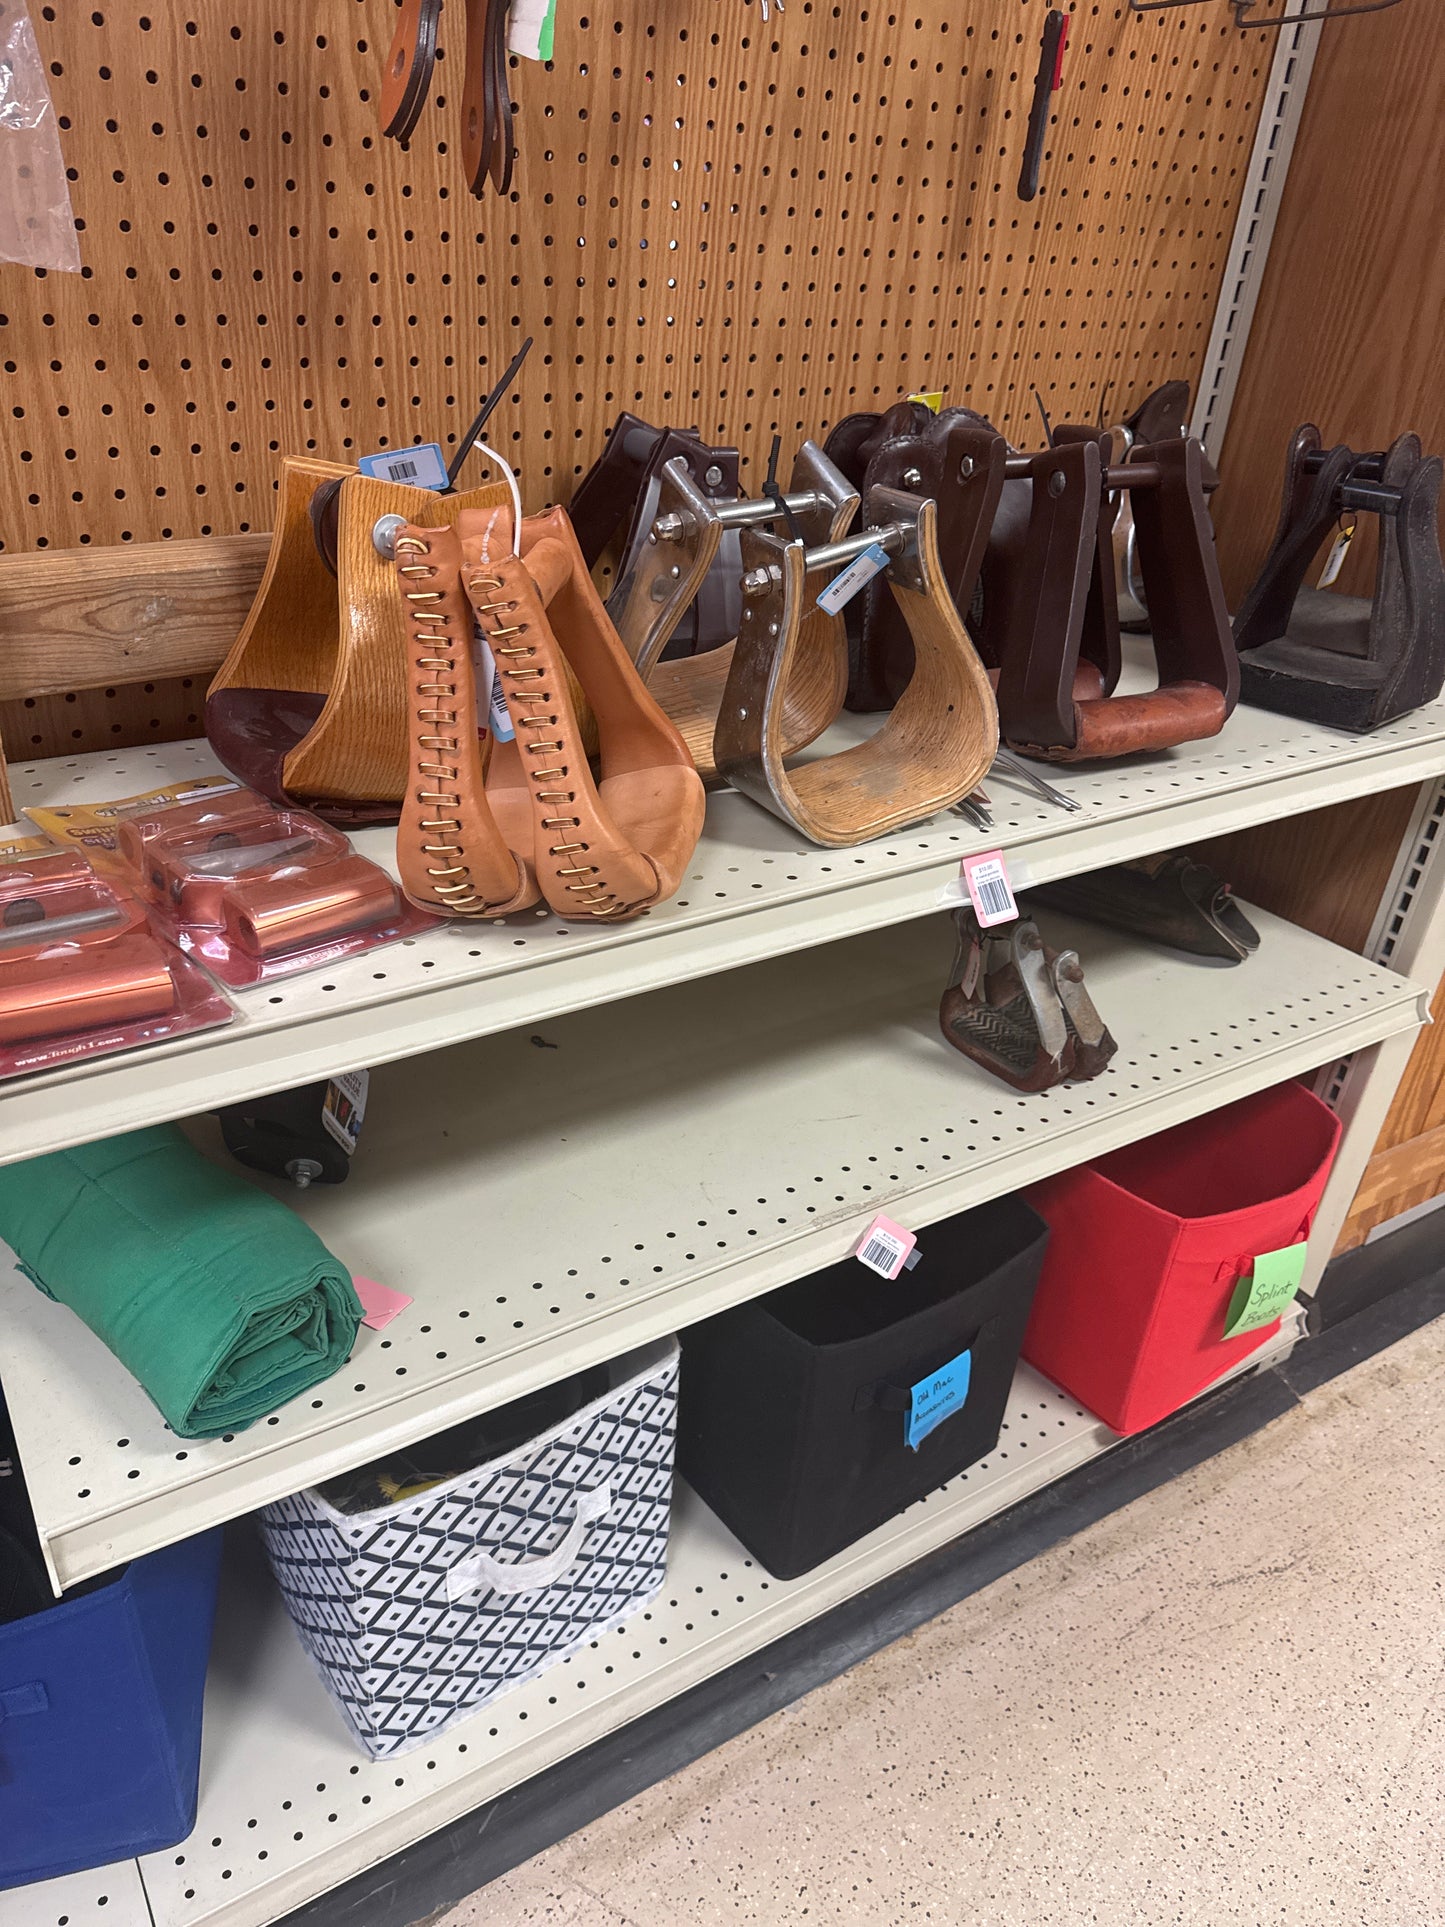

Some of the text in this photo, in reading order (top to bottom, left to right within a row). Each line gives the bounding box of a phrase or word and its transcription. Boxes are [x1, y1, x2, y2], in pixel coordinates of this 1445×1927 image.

[14, 1036, 125, 1066] www.Tough1.com
[1250, 1280, 1293, 1307] Splint
[1240, 1306, 1281, 1327] Boots
